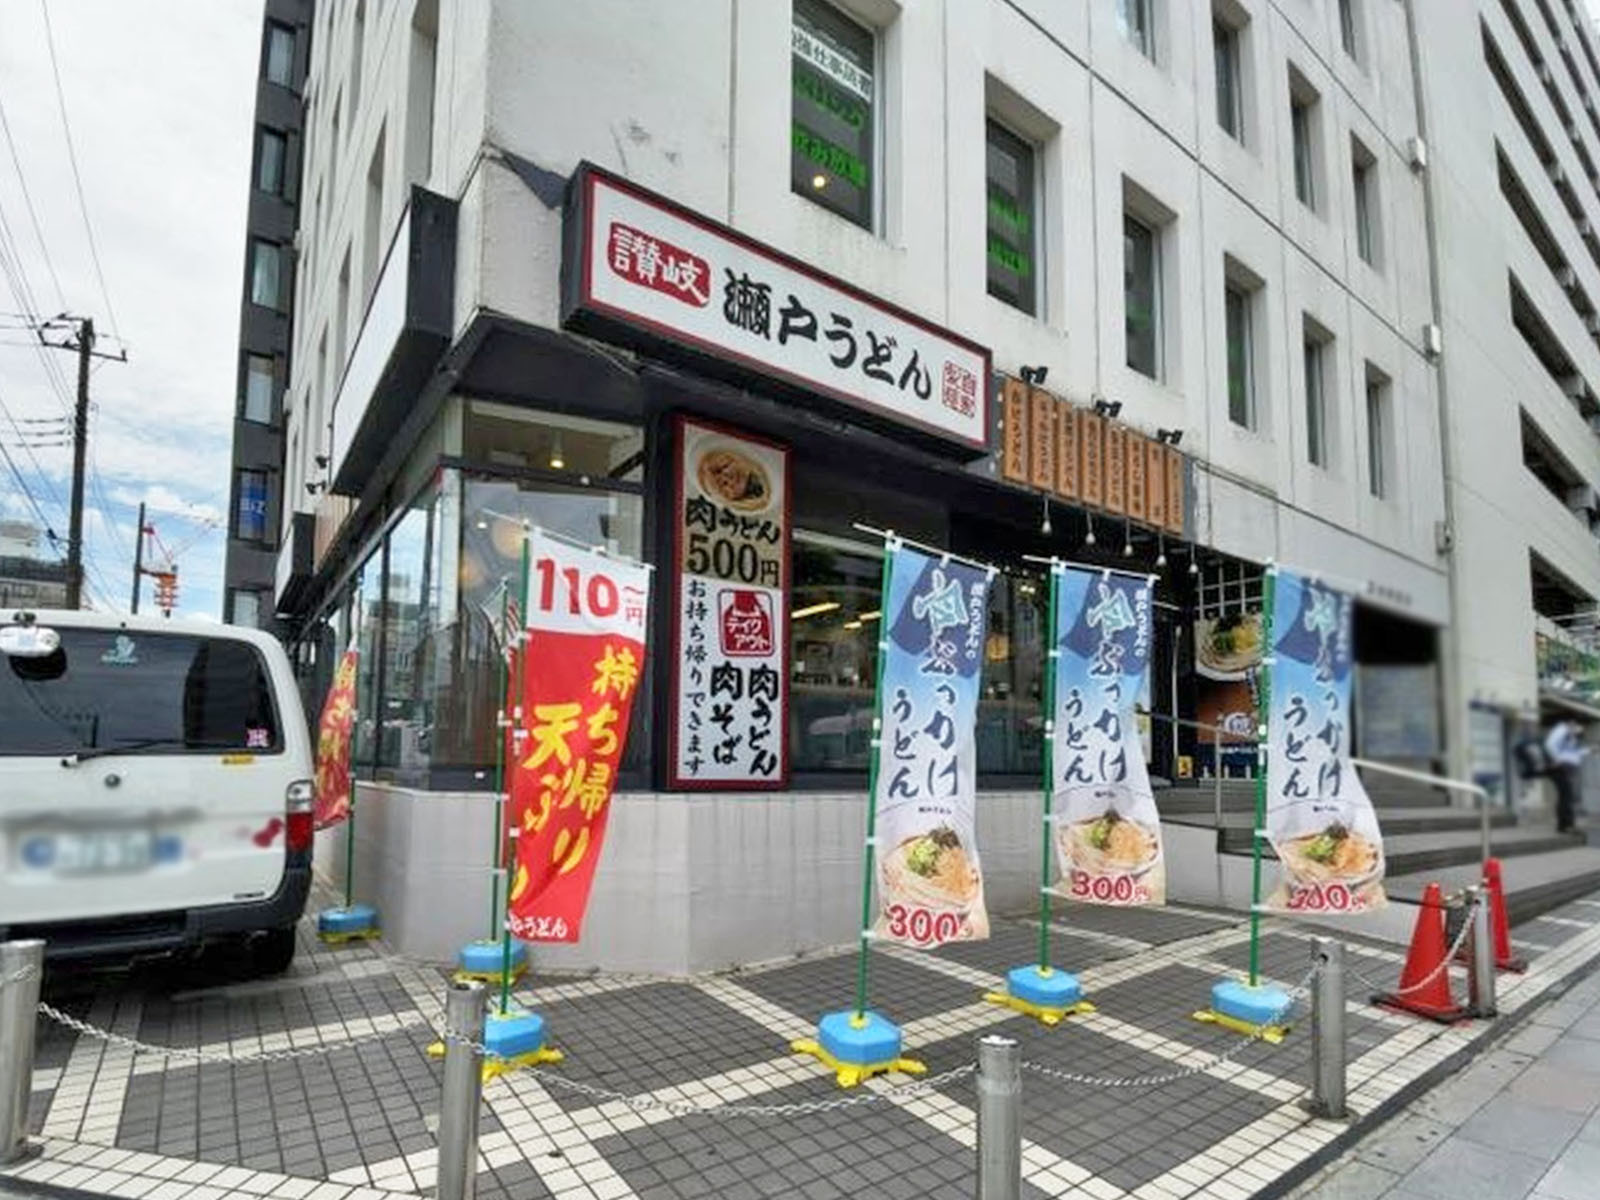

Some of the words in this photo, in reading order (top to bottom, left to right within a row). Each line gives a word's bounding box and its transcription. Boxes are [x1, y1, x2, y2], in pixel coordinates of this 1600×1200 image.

[721, 267, 932, 401] 瀬戸うどん
[685, 495, 780, 544] 肉うどん
[687, 534, 780, 588] 500円
[684, 580, 709, 776] お持ち帰りできます
[726, 617, 762, 634] テイク
[710, 661, 744, 765] 肉そば
[747, 664, 779, 776] 肉うどん
[912, 568, 970, 797] 肉ぶっかけ
[1086, 581, 1137, 783] 肉ぶっかけ
[553, 644, 638, 876] 持ち帰り
[888, 689, 920, 799] うどん
[1064, 690, 1093, 785] うどん
[1282, 696, 1310, 798] うどん
